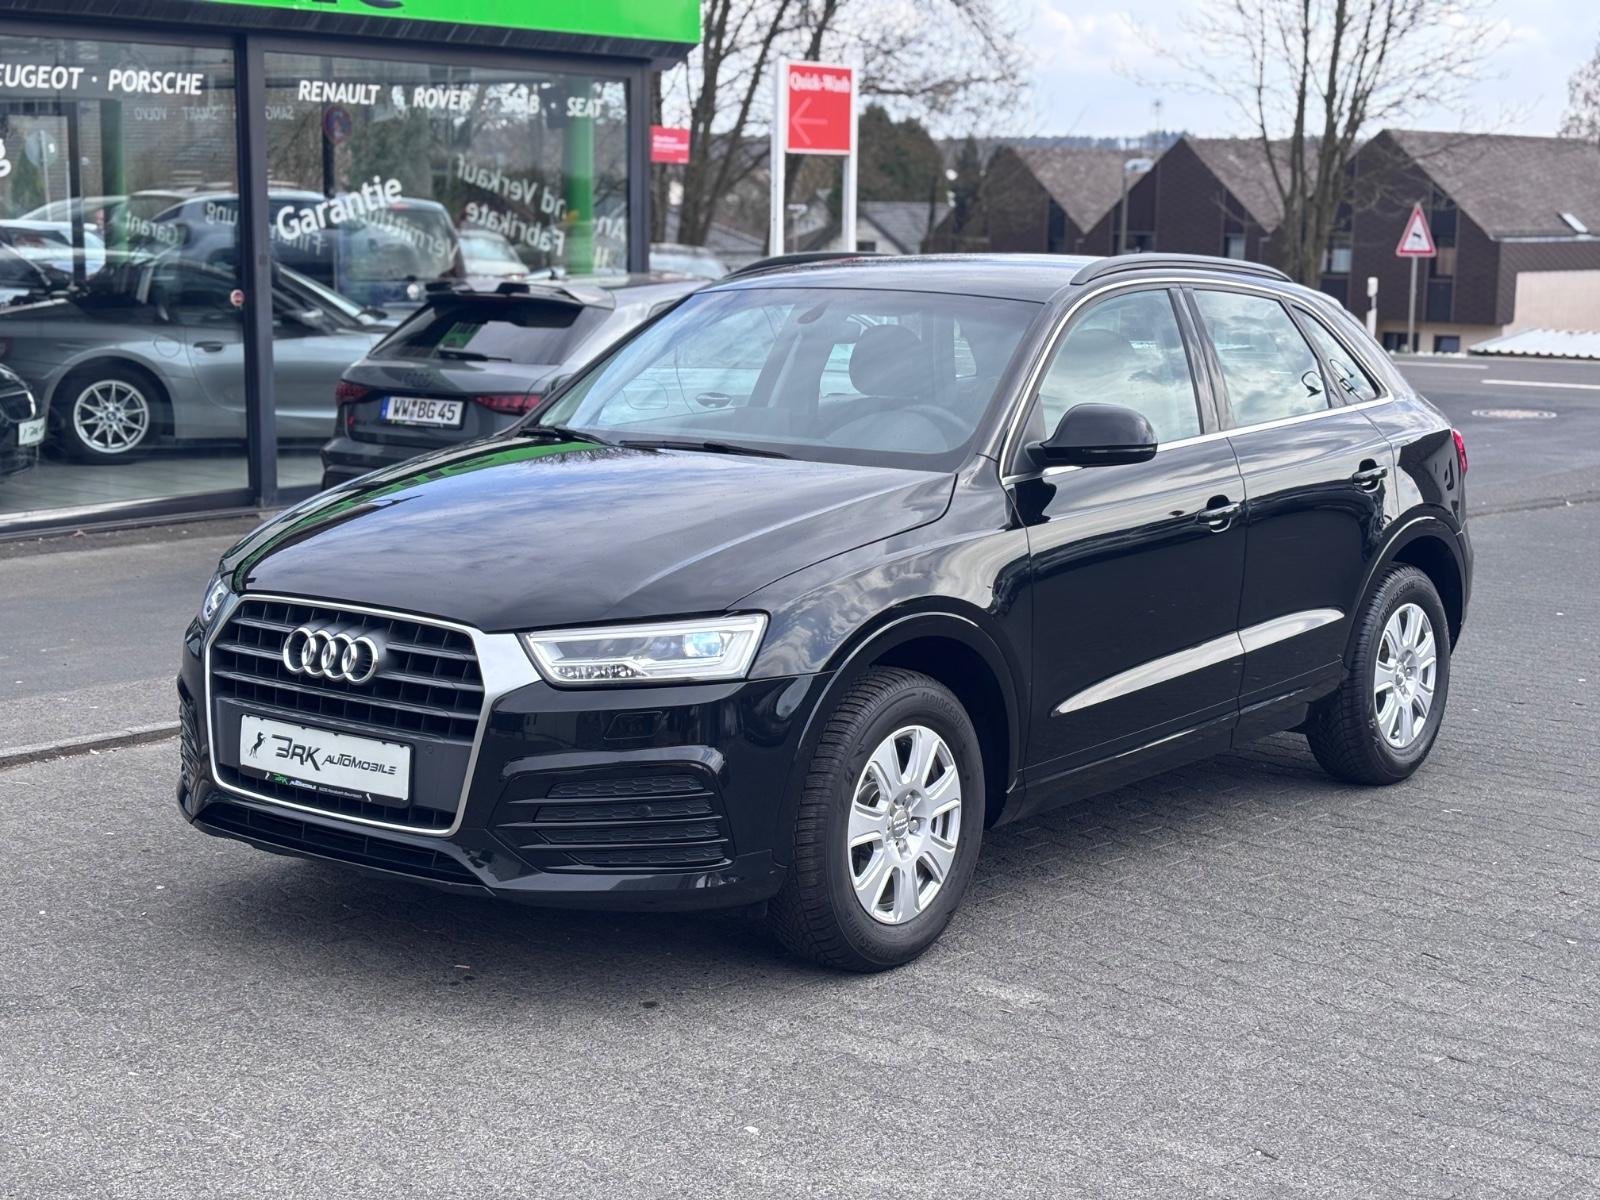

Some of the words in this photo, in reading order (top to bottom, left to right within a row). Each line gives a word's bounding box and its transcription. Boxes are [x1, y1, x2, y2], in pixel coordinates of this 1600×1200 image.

[108, 69, 204, 95] PORSCHE
[298, 80, 381, 105] RENAULT
[413, 86, 472, 110] ROVER
[566, 96, 604, 117] SEAT
[277, 175, 403, 240] Garantie
[393, 400, 410, 417] WW
[417, 402, 435, 419] BG
[438, 404, 457, 421] 45
[321, 753, 397, 775] AUTOMOBILE
